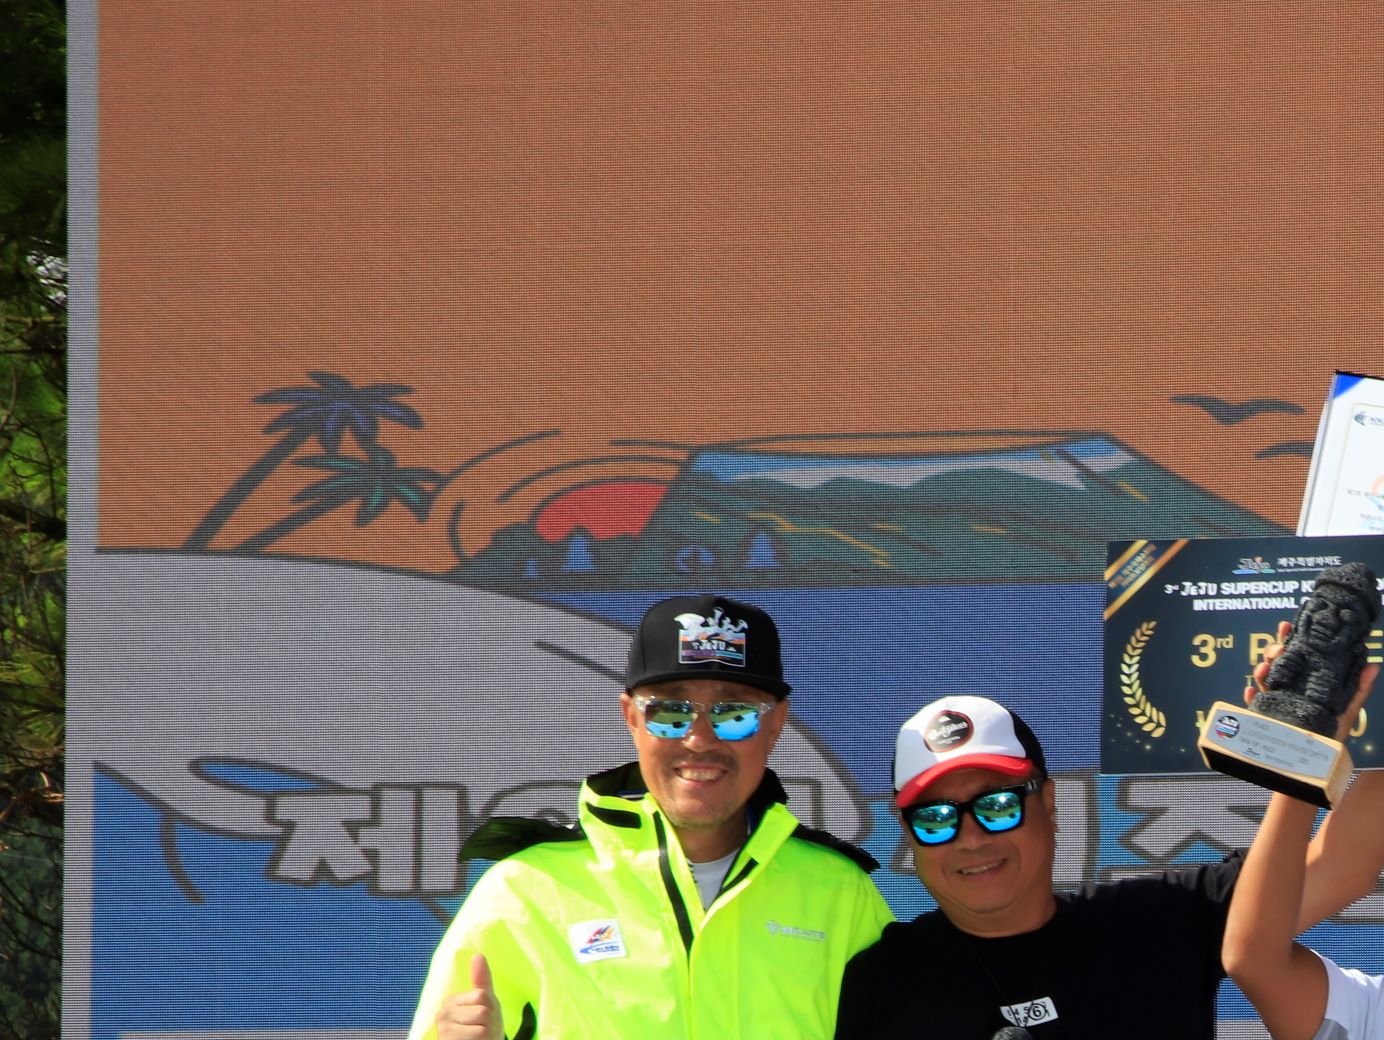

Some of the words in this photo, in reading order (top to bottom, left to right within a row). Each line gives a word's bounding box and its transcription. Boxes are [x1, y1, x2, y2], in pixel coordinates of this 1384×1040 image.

[1220, 580, 1300, 595] SUPERCUP
[1192, 596, 1299, 612] INTERNATIONAL
[1190, 632, 1234, 668] 3rd
